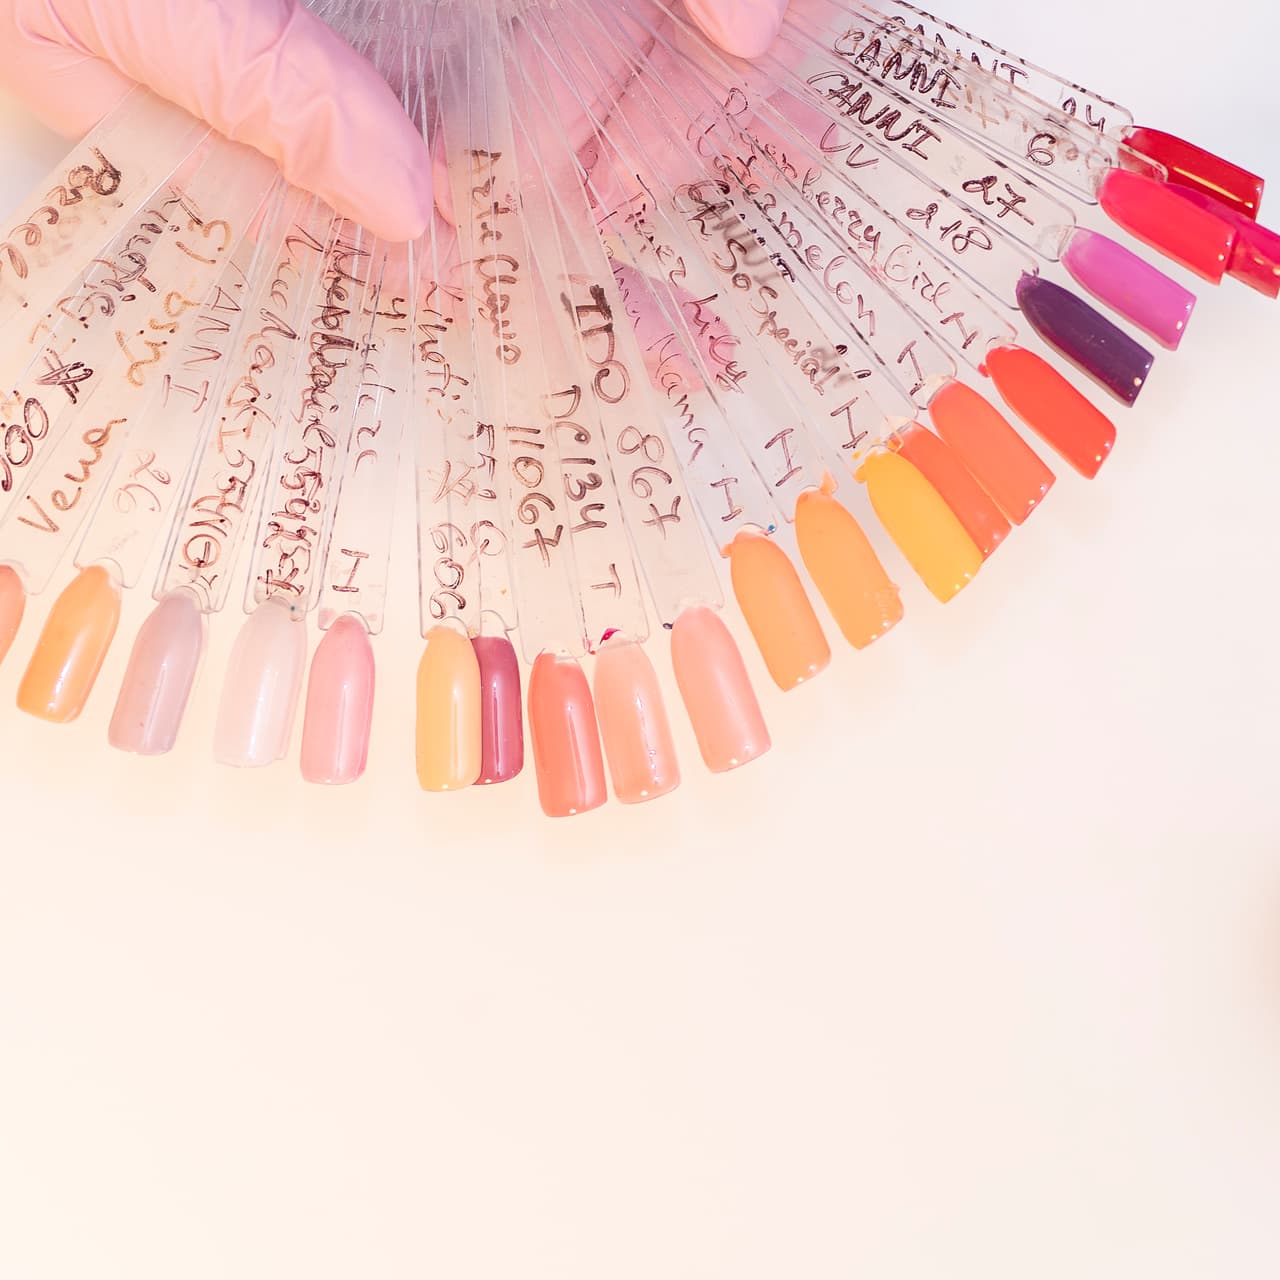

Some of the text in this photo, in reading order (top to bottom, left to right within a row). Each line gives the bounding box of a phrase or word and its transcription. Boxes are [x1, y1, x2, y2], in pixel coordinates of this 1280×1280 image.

[807, 71, 942, 160] CANNI
[962, 175, 1035, 226] 27
[906, 202, 992, 254] 218
